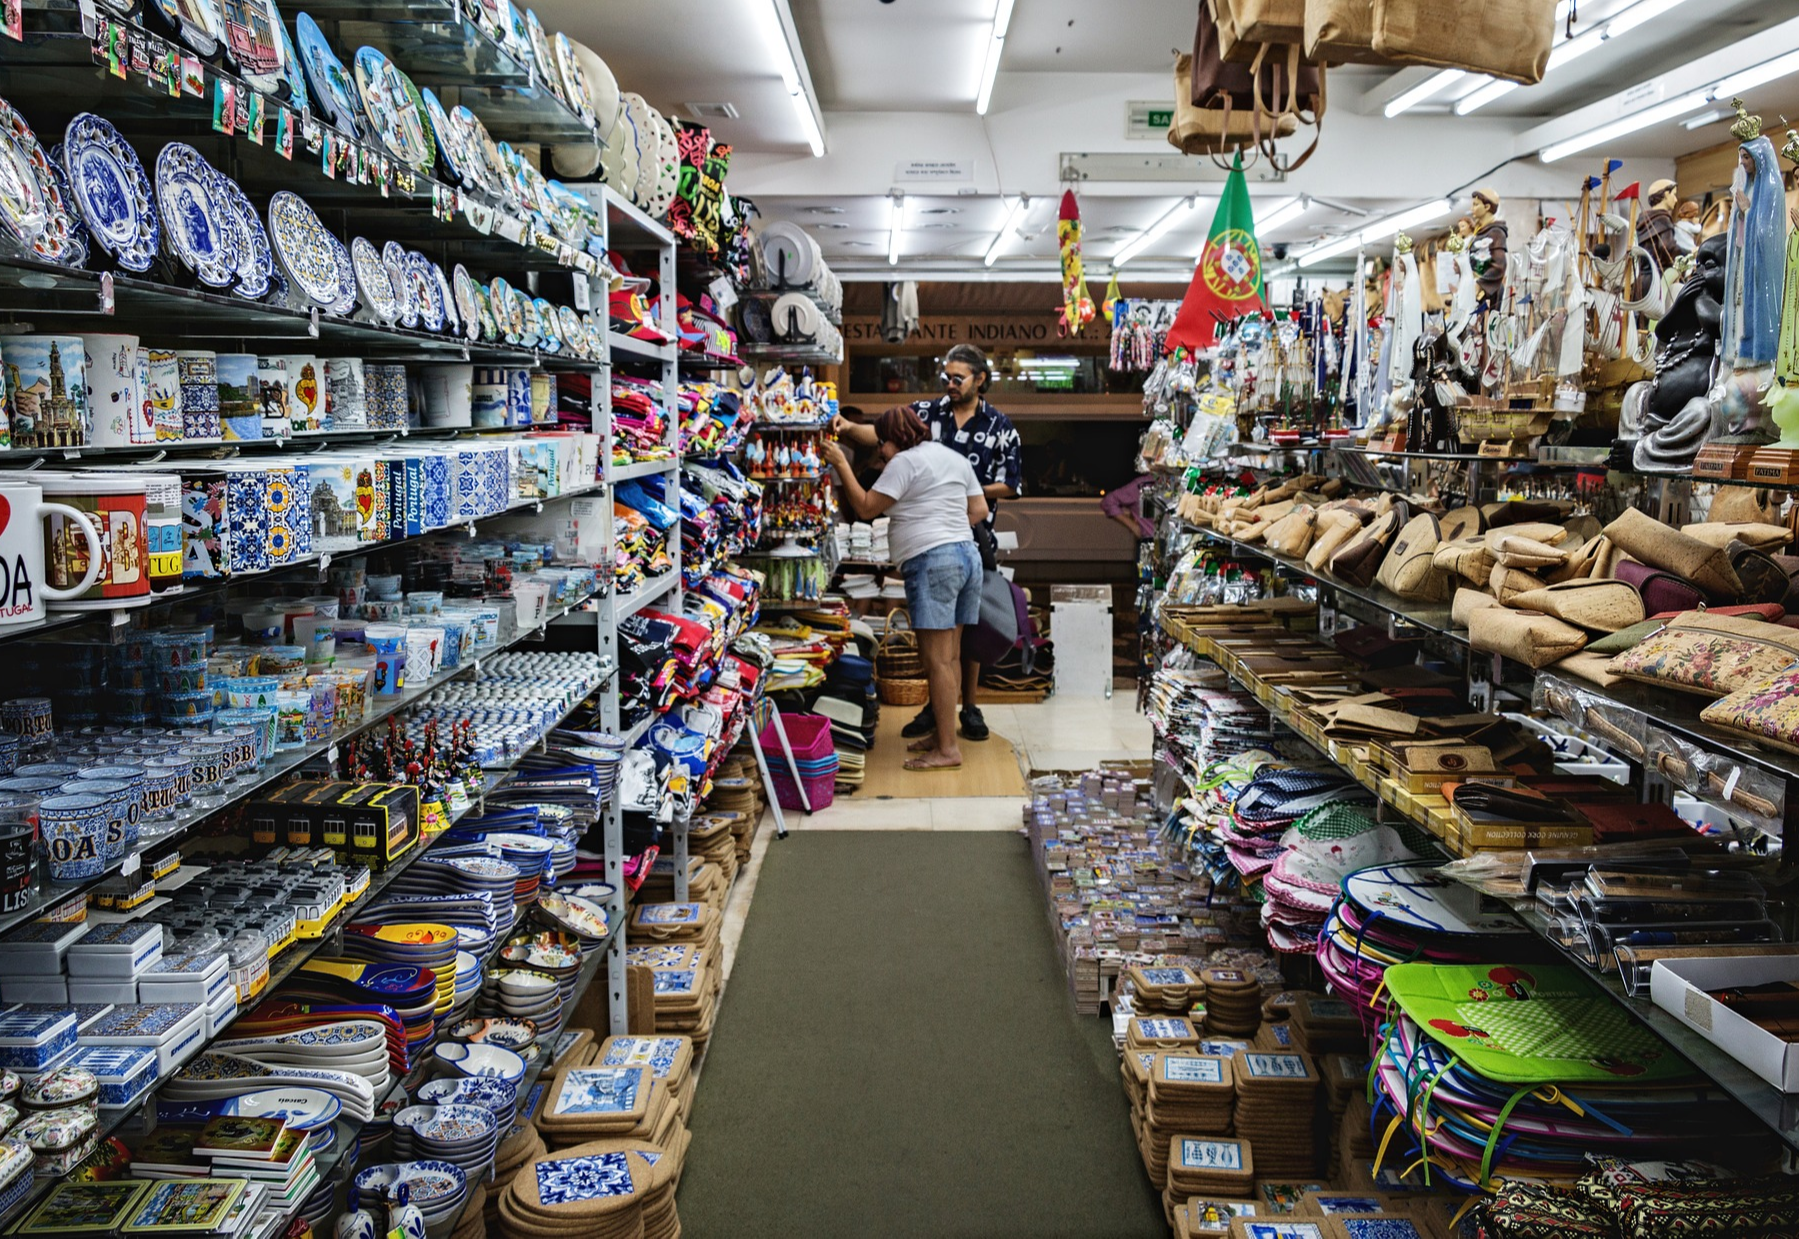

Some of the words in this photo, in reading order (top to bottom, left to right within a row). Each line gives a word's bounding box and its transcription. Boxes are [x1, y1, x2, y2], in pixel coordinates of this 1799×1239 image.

[1153, 114, 1170, 124] SA
[969, 323, 1047, 340] INDIANO
[547, 448, 555, 487] Portugal
[1755, 467, 1780, 477] FATIMA
[392, 470, 402, 530] Portugal
[407, 466, 418, 523] Portugal
[149, 556, 182, 574] TUG
[0, 603, 33, 619] TUGAL
[2, 713, 52, 737] PORTU
[1486, 831, 1527, 840] COLLECTION
[1527, 831, 1547, 840] CORK
[3, 886, 30, 912] LIS
[278, 1097, 308, 1105] Cascais
